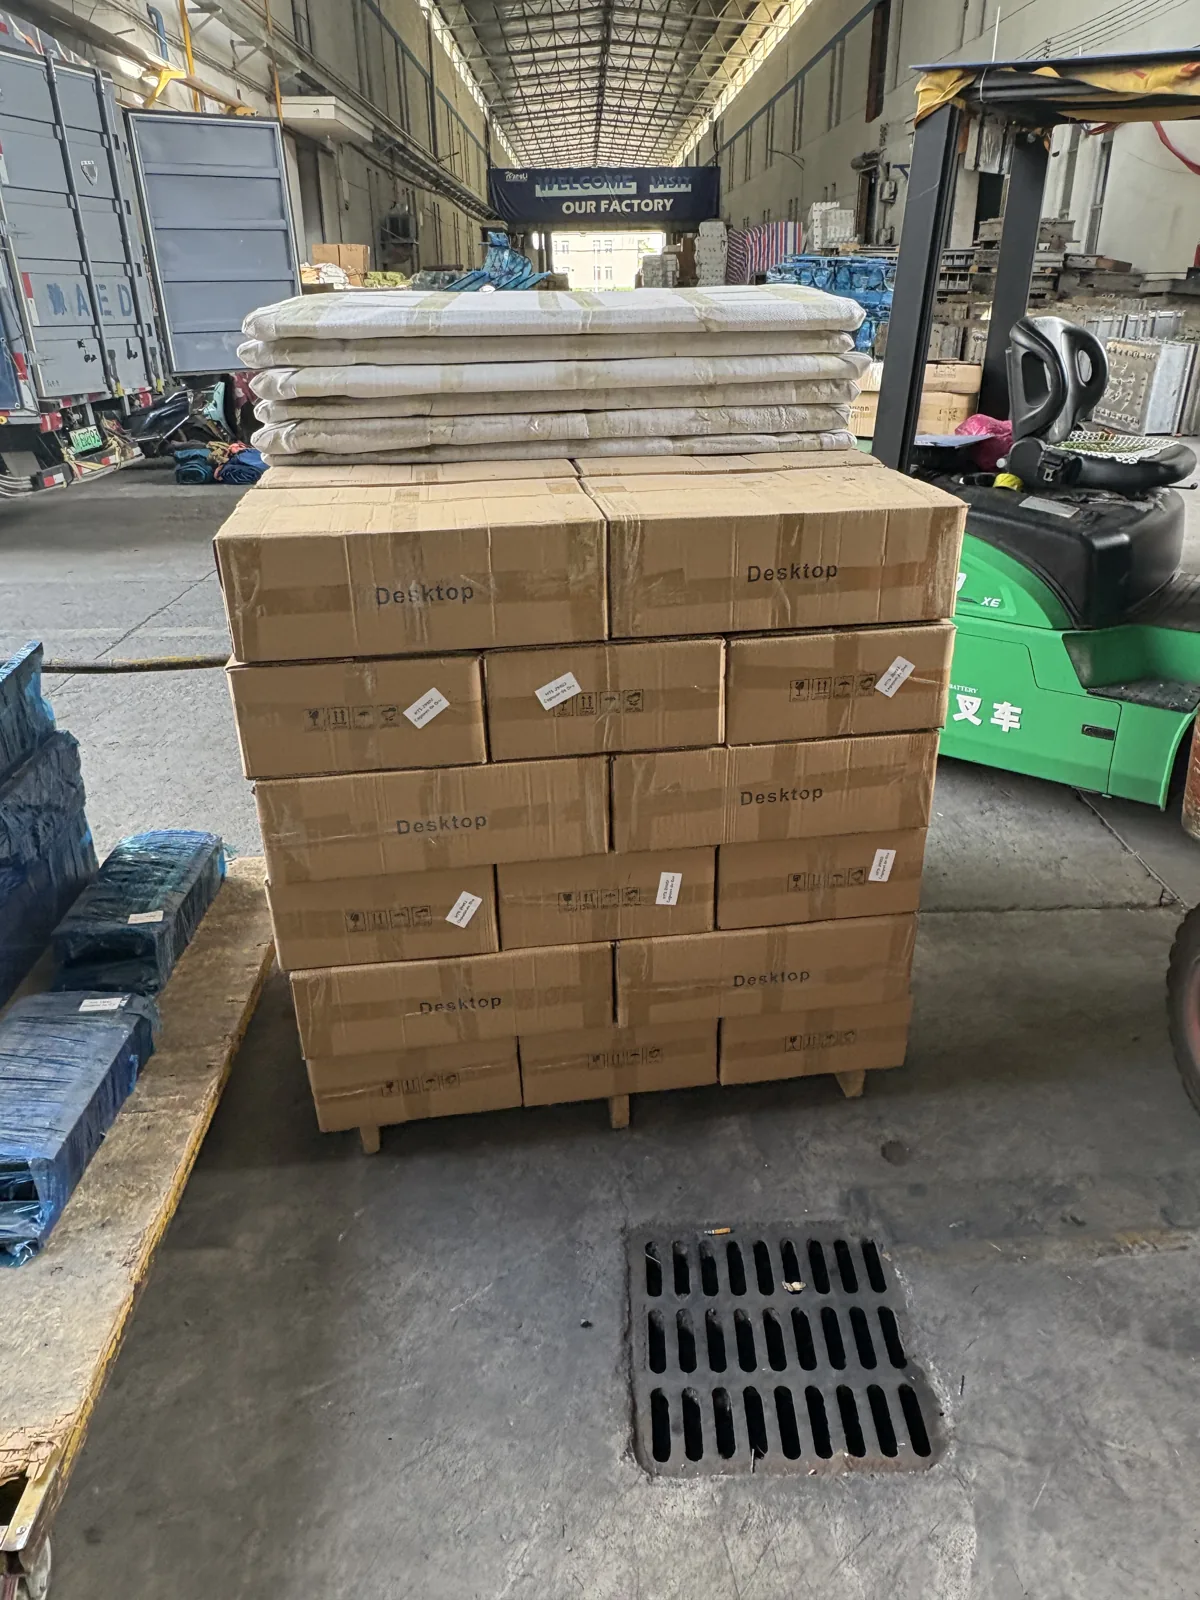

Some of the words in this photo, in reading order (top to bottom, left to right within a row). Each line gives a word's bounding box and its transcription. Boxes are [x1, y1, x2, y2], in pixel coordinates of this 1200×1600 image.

[536, 174, 634, 191] WELCOME
[651, 175, 691, 190] VISIT
[562, 200, 597, 214] OUR
[600, 198, 674, 214] FACTORY
[747, 562, 838, 583] Desktop
[376, 583, 475, 606] Desktop
[980, 596, 1001, 607] XE
[952, 694, 1023, 733] 叉车
[741, 788, 824, 806] Desktop
[396, 814, 488, 835] Desktop
[733, 969, 811, 988] Desktop
[419, 995, 502, 1015] Desktop
